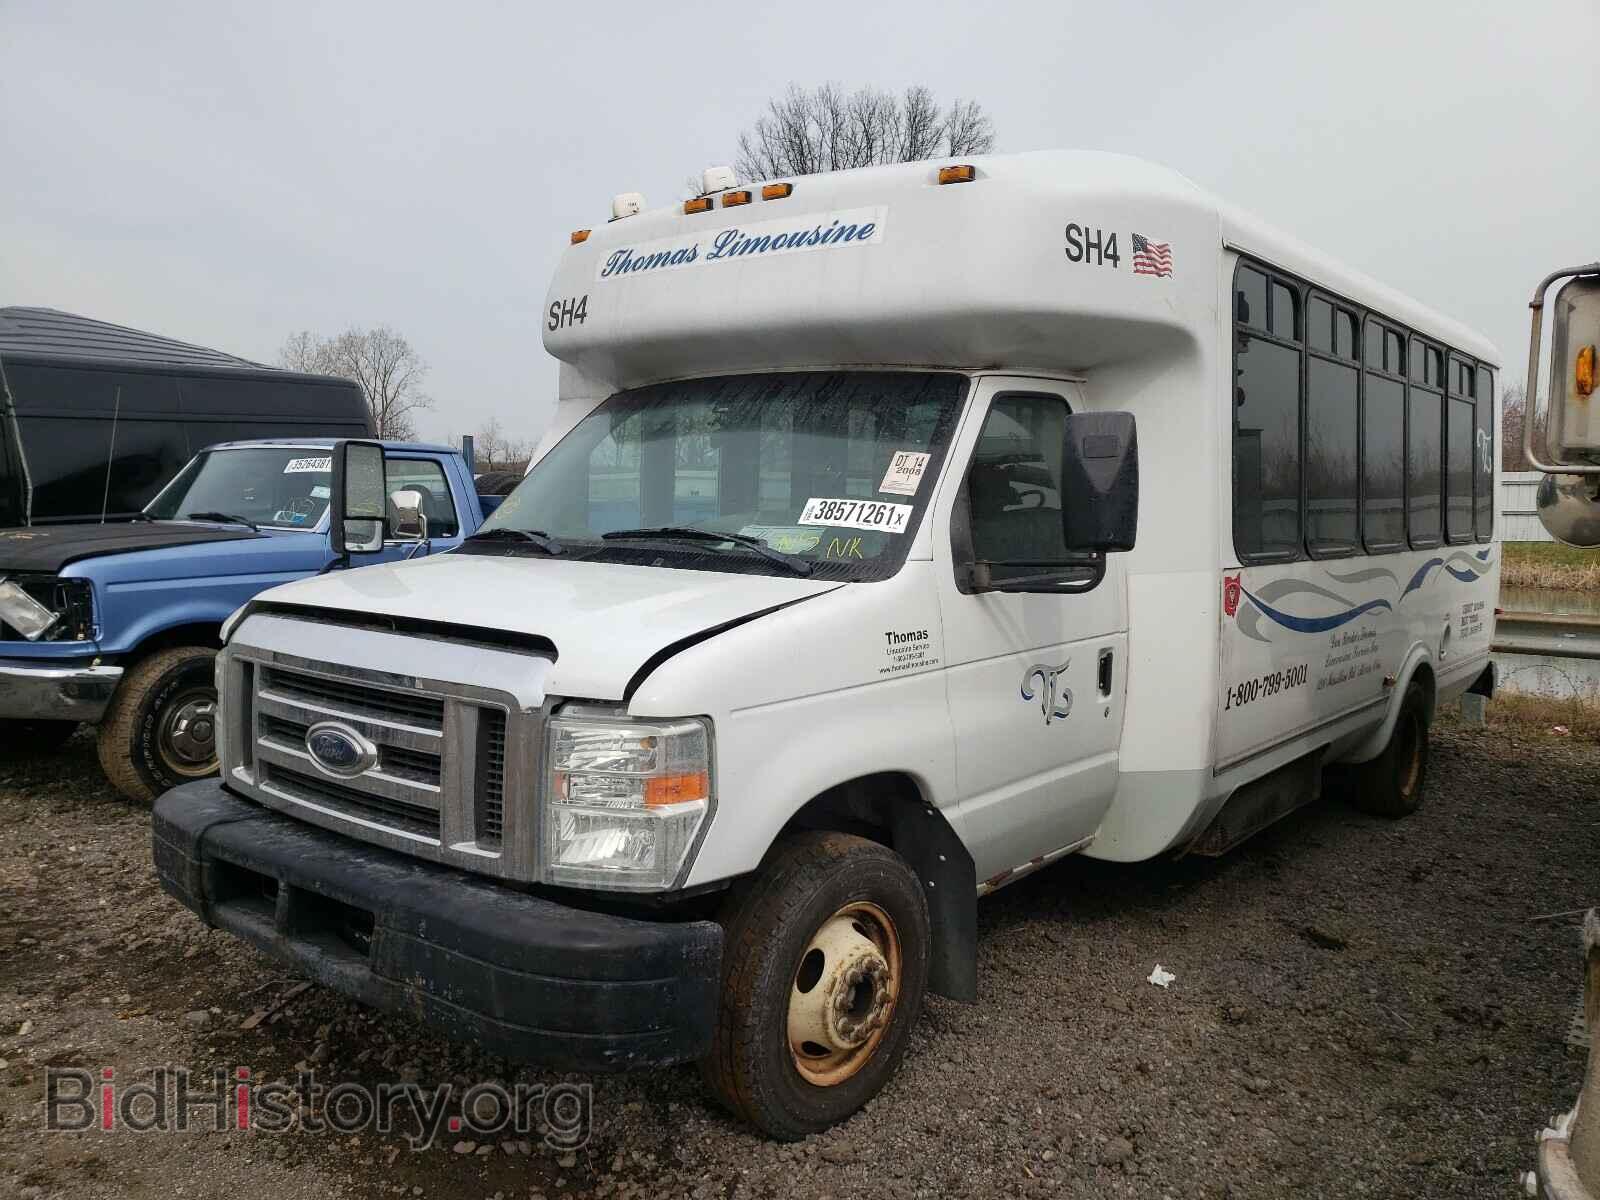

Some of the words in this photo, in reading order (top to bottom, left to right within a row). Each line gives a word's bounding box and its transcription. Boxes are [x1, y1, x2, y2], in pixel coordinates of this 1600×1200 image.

[601, 243, 699, 278] Thomas
[706, 219, 876, 261] Limousine
[1065, 222, 1120, 269] SH4
[548, 294, 589, 332] SH4
[895, 466, 922, 476] 2008
[826, 536, 864, 560] NK
[885, 629, 929, 645] Thomas
[1225, 663, 1308, 711] 1-800-799-5001
